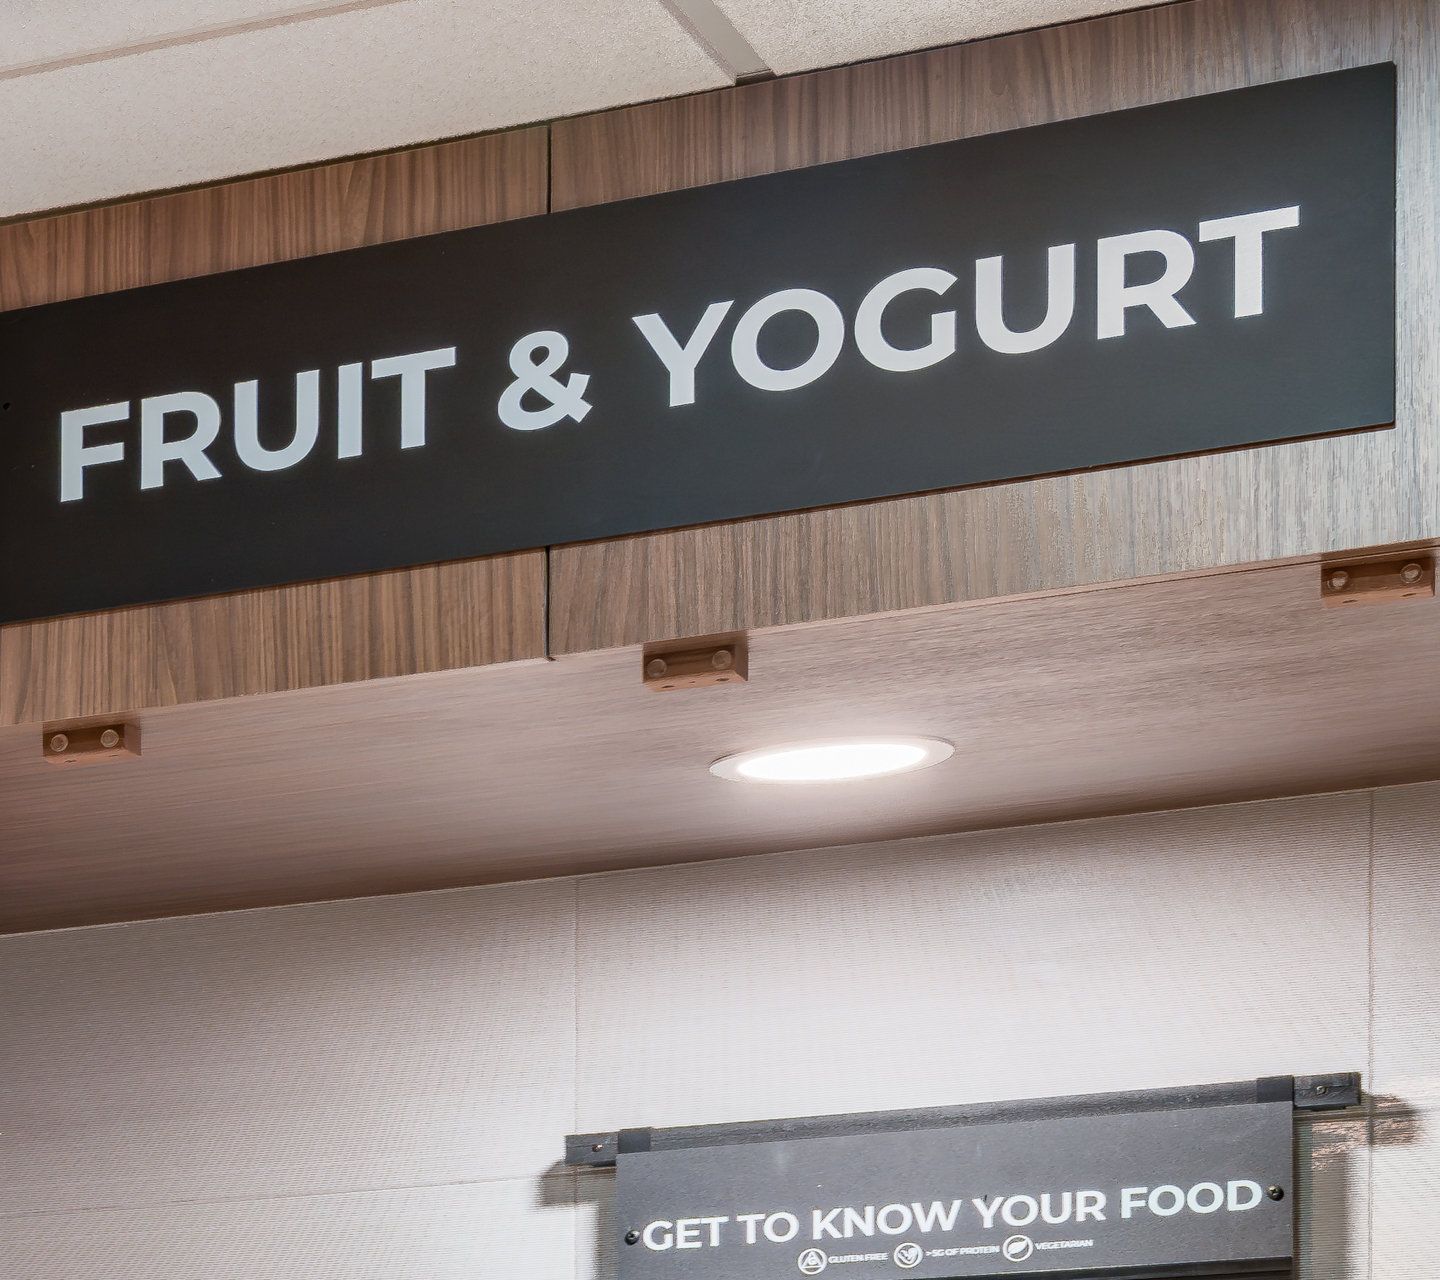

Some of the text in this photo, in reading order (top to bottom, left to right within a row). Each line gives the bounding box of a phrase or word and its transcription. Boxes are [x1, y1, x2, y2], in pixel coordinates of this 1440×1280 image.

[60, 206, 1300, 503] FRUIT & YOGURT
[642, 1179, 1264, 1252] GET TO KNOW YOUR FOOD
[1034, 1239, 1093, 1250] VEGETARIAN
[945, 1248, 958, 1257] OF
[959, 1245, 1000, 1256] PROTEIN
[828, 1252, 888, 1264] GLUTEN FREE
